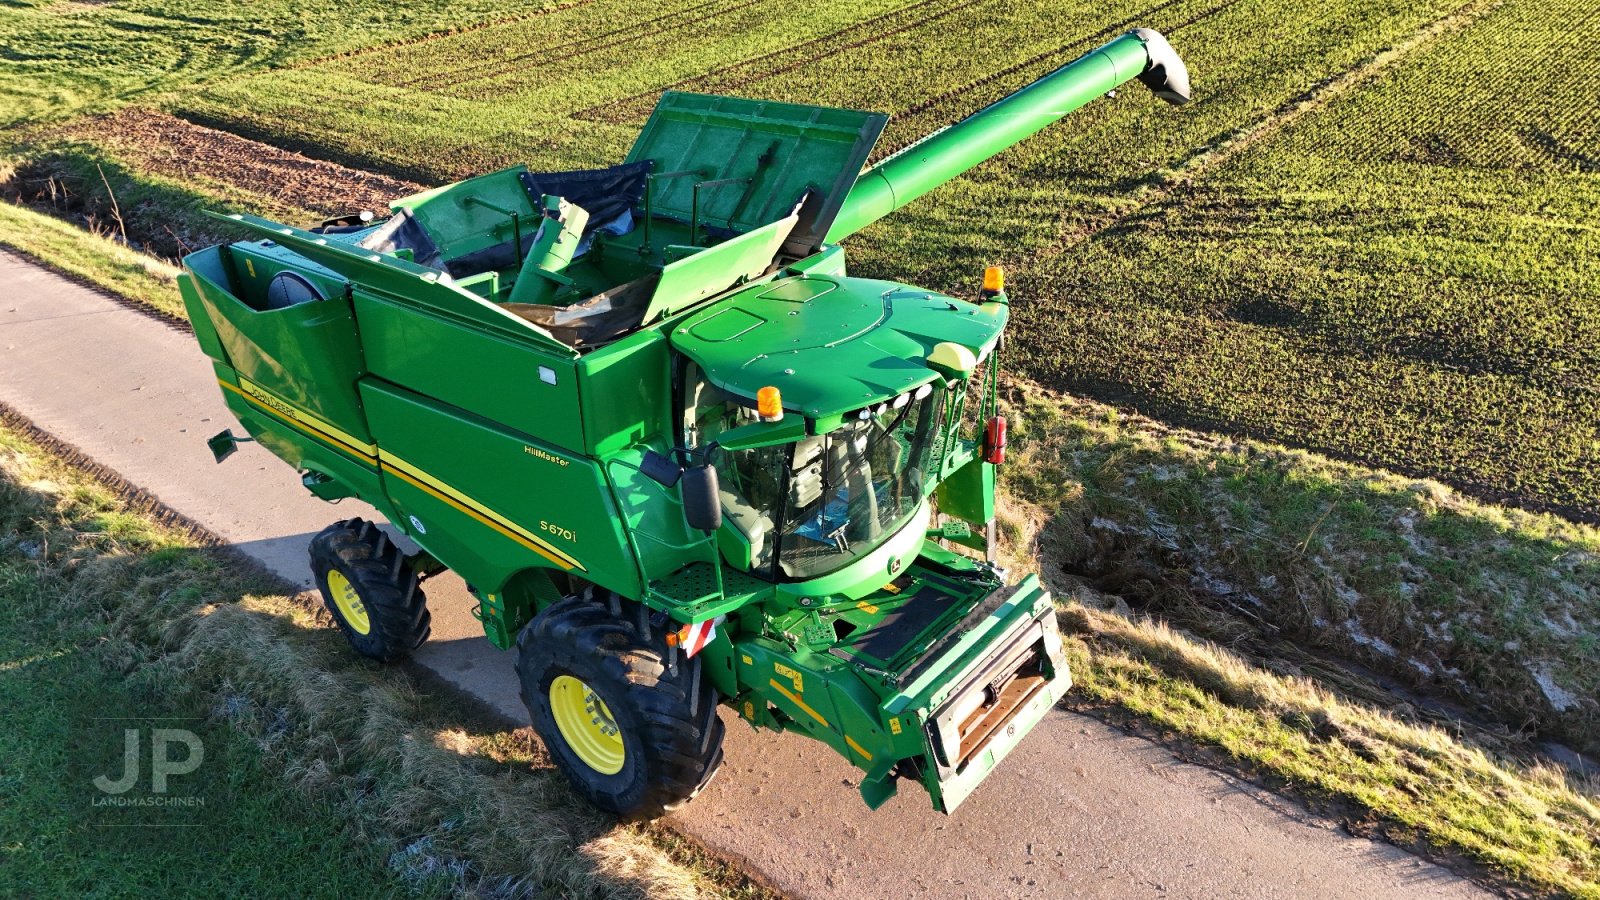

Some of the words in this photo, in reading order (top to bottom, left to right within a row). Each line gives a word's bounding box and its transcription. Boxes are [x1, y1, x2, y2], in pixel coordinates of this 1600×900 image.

[251, 385, 270, 405] JOHN
[270, 396, 297, 418] DEERE
[524, 445, 570, 467] HillMaster
[540, 520, 548, 530] S
[549, 524, 577, 543] 670i
